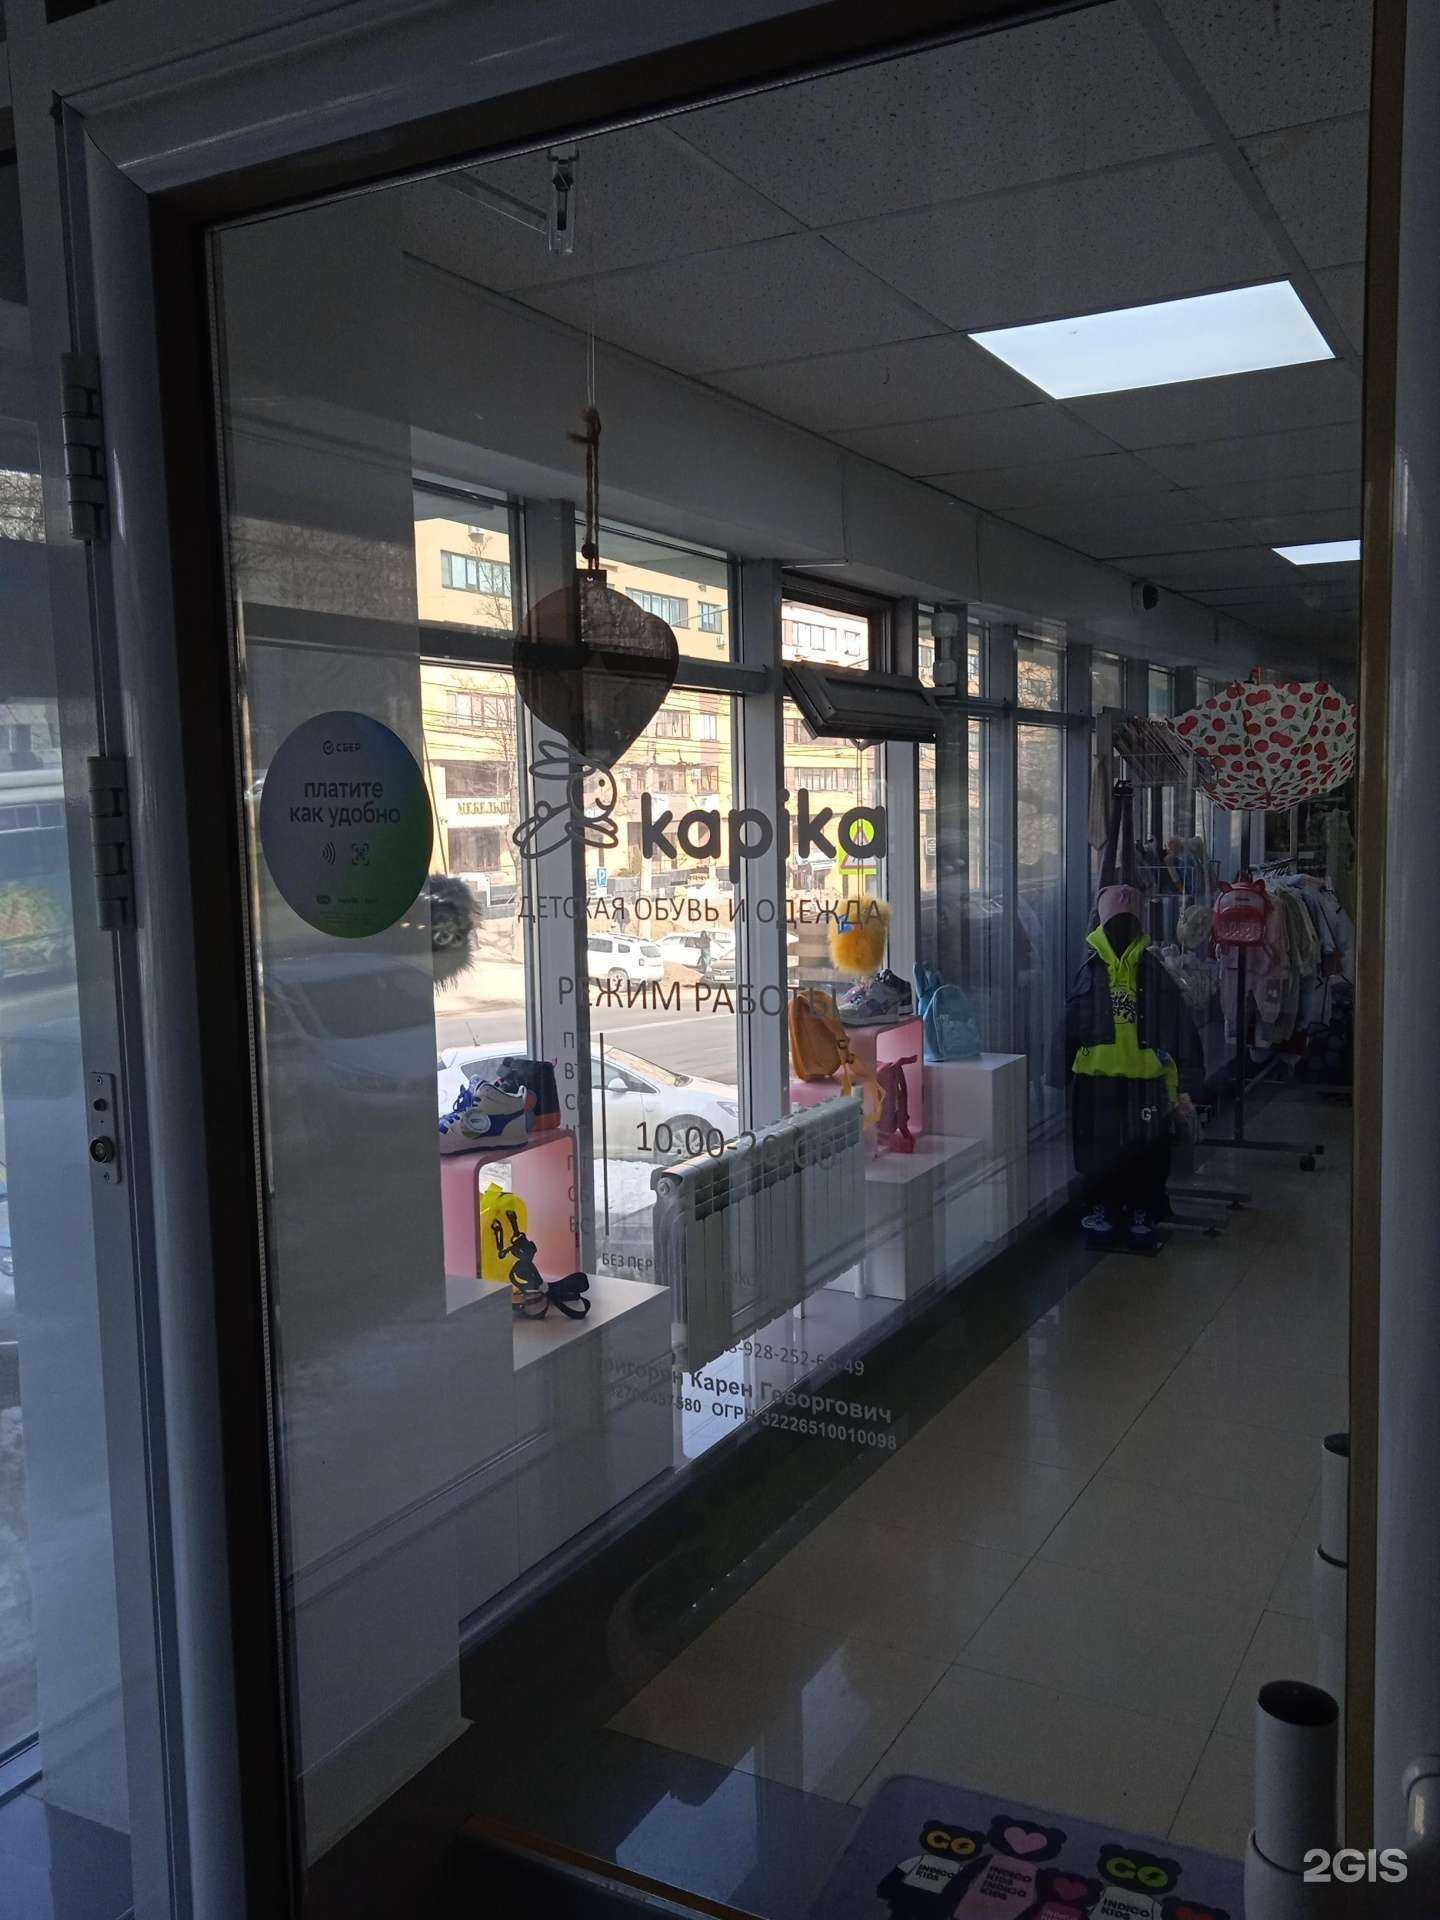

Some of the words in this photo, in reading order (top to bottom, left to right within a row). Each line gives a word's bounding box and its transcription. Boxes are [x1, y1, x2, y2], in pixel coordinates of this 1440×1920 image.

[304, 780, 383, 798] платите
[290, 805, 324, 823] как
[329, 802, 401, 828] удобно
[641, 788, 888, 884] kapika
[634, 896, 720, 922] ОБУВЬ
[756, 899, 883, 926] ОДЕЖДА
[602, 1252, 624, 1267] БЕЗ
[691, 1371, 753, 1398] Карен
